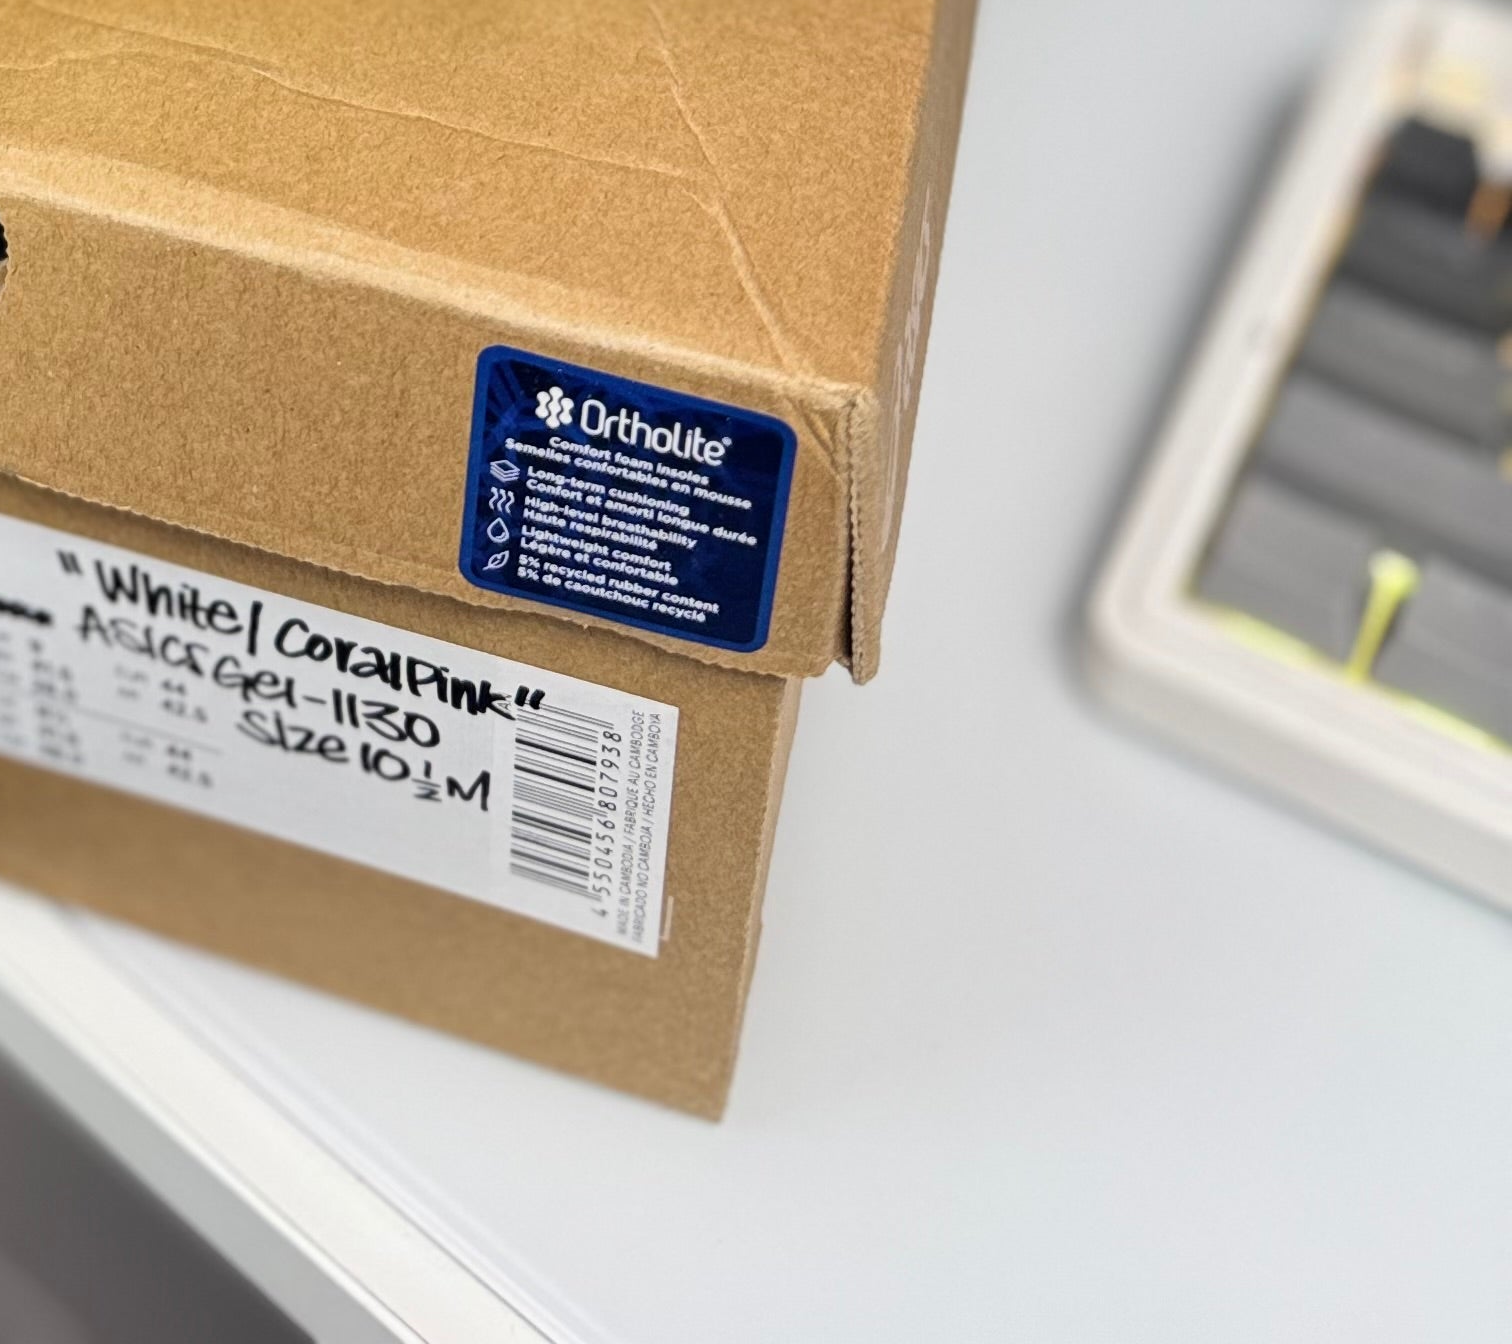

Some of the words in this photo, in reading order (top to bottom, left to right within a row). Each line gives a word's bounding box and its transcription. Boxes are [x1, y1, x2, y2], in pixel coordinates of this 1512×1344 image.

[505, 437, 571, 465] Semelles
[573, 457, 668, 489] confortables
[670, 481, 691, 494] en
[693, 486, 752, 510] mousse
[549, 436, 611, 461] Comfort
[614, 451, 654, 472] foam
[526, 478, 583, 502] Confort
[585, 494, 603, 507] et
[604, 499, 655, 520] amorti
[656, 510, 710, 533] longue
[712, 526, 758, 546] durée
[527, 465, 606, 494] Long-term
[608, 488, 690, 517] cushioning
[523, 507, 567, 528] Haute
[569, 521, 658, 551] respirabilité
[524, 495, 599, 523] High-level
[601, 514, 698, 550] breathability
[520, 536, 571, 560] Légère
[573, 552, 590, 564] et
[592, 557, 679, 586] confortable
[521, 524, 609, 557] Lightweight
[611, 549, 672, 572] comfort
[517, 566, 540, 582] 5%
[541, 573, 562, 587] de
[564, 580, 650, 609] caoutchouc
[652, 601, 706, 623] recyclé
[518, 553, 540, 569] 5%
[543, 561, 606, 585] recycled
[608, 578, 660, 598] rubber
[661, 592, 720, 614] content
[628, 709, 645, 770] CAMBODGE
[646, 712, 662, 763] CAMBOYA
[627, 771, 641, 786] AU
[644, 763, 657, 779] EN
[623, 786, 639, 834] FABRIQUE
[641, 779, 656, 817] HECHO
[636, 872, 649, 889] NO
